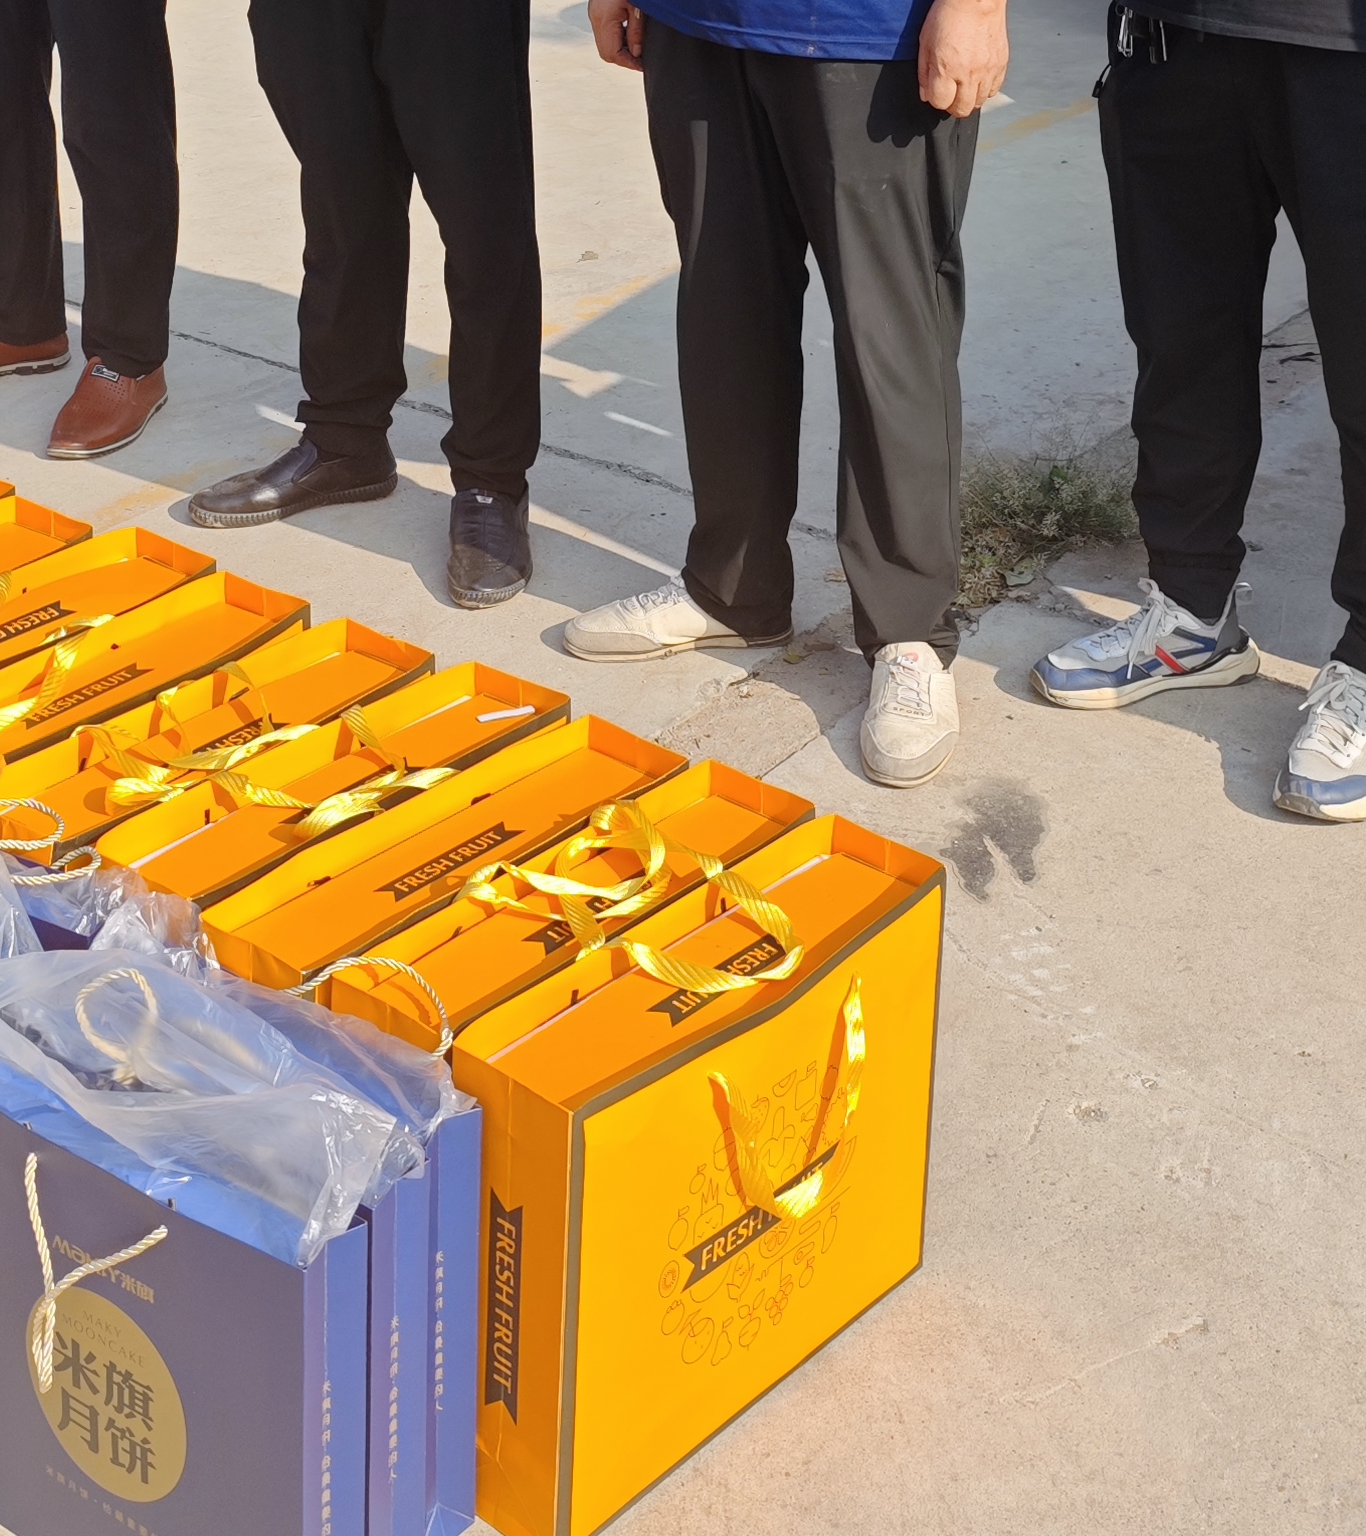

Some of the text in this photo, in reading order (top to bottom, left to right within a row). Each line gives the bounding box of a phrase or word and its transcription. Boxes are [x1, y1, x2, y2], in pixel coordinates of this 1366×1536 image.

[3, 605, 61, 633] FRESH
[28, 670, 133, 723] FRESH FRUIT
[394, 830, 503, 893] FRESH FRUIT
[699, 1207, 764, 1272] FRESH
[81, 1308, 123, 1340] MAKY
[492, 1215, 518, 1395] FRESH FRUIT
[60, 1311, 146, 1370] MOONCAKE
[53, 1330, 156, 1433] 米旗
[56, 1384, 157, 1487] 月饼
